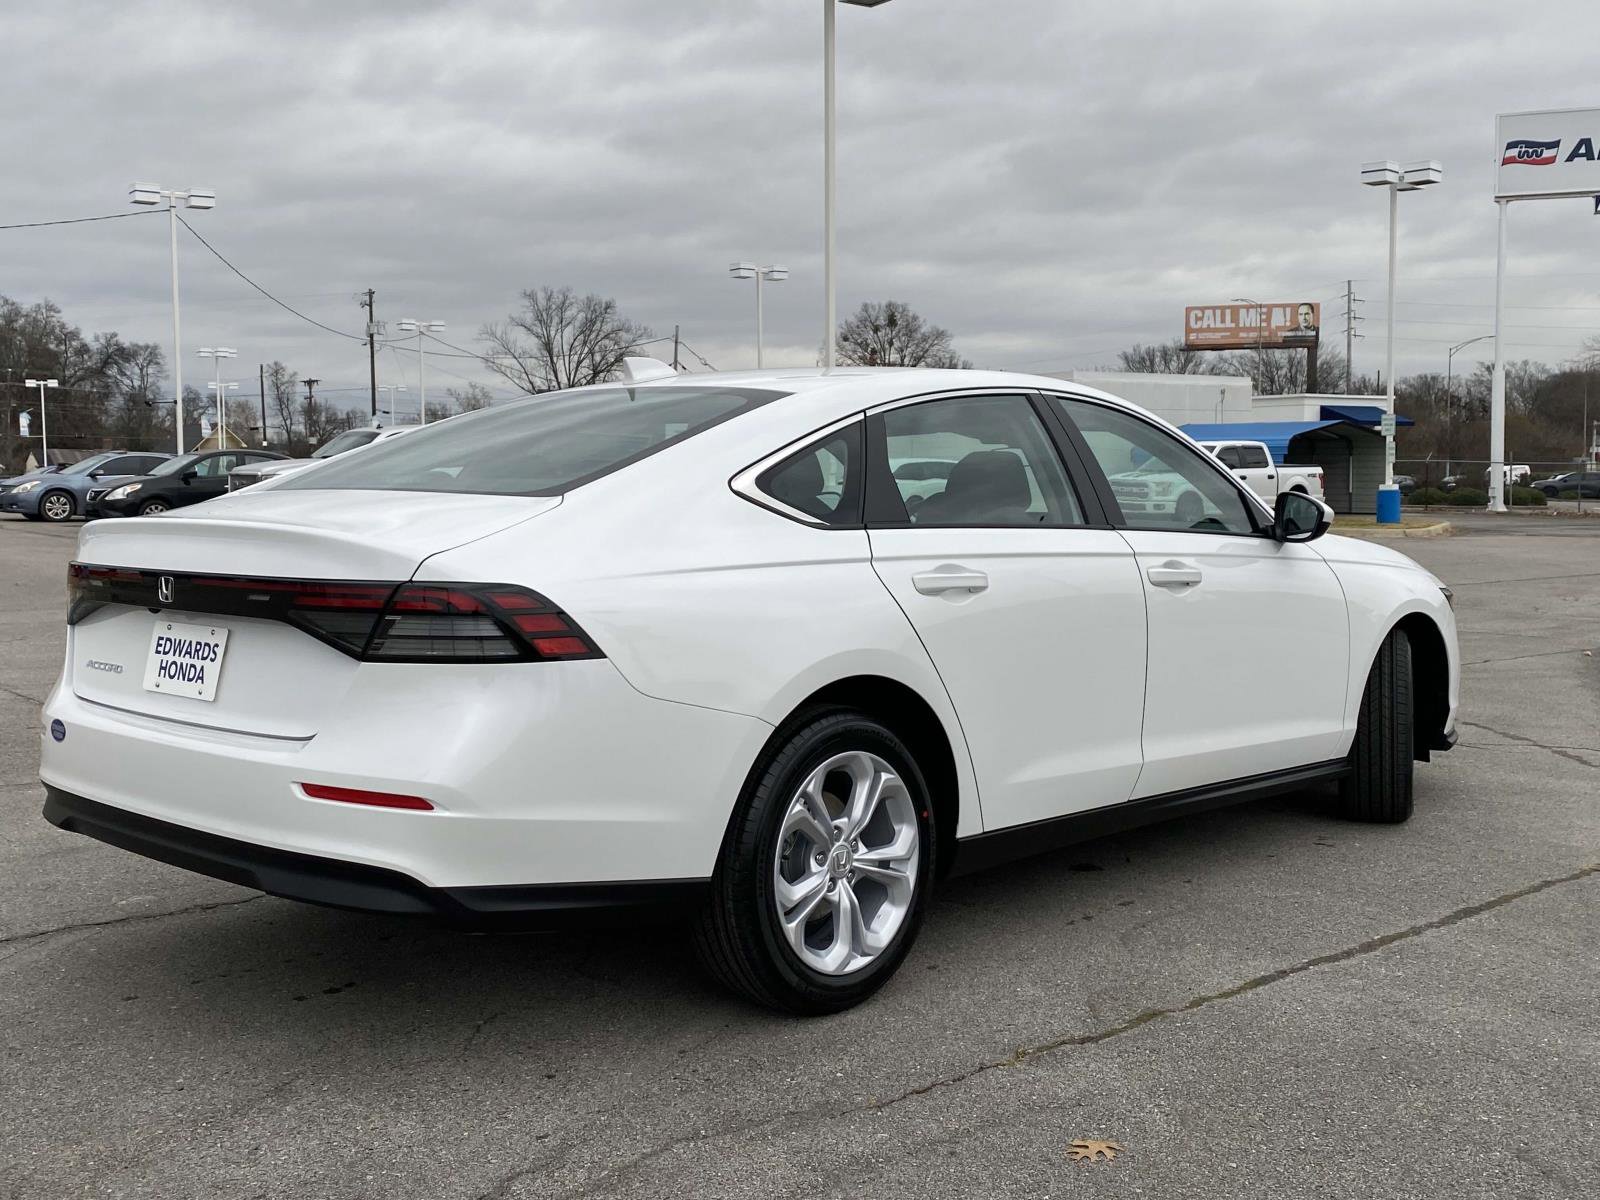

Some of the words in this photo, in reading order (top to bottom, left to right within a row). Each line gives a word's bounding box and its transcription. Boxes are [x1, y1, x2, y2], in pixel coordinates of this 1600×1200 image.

[1564, 137, 1600, 162] A
[1190, 308, 1235, 329] CALL
[1239, 307, 1268, 328] ME
[154, 636, 219, 663] EDWARDS
[157, 659, 205, 684] HONDA
